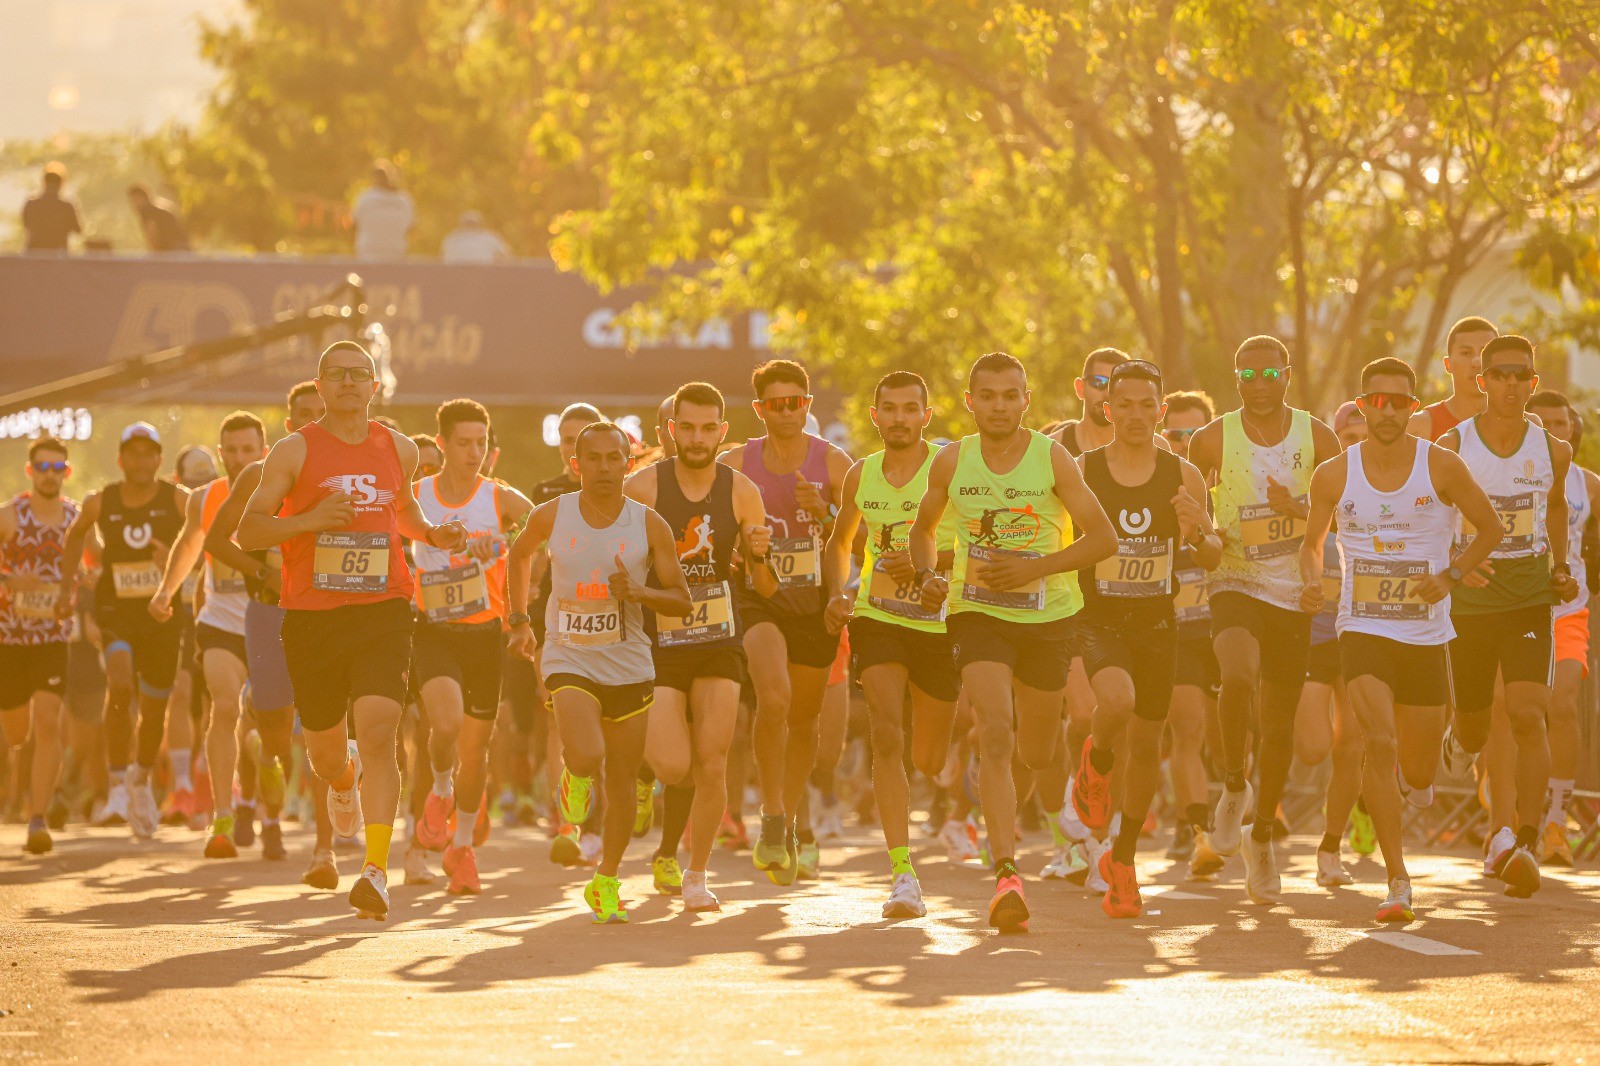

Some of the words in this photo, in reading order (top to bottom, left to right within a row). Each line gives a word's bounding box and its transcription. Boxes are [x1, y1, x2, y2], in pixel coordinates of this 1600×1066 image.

[1516, 499, 1531, 507] ELITE
[1000, 529, 1034, 540] ZAPPIA
[1268, 517, 1294, 541] 90
[371, 538, 388, 546] ELITE
[795, 541, 810, 550] ELITE
[1151, 545, 1166, 554] ELITE
[341, 551, 371, 574] 65
[1117, 559, 1155, 581] 100
[1408, 566, 1426, 574] ELITE
[445, 584, 464, 605] 81
[707, 588, 722, 597] ELITE
[895, 580, 921, 602] 88
[1377, 579, 1407, 602] 84
[566, 613, 617, 634] 14430
[686, 627, 708, 636] ALFREDO
